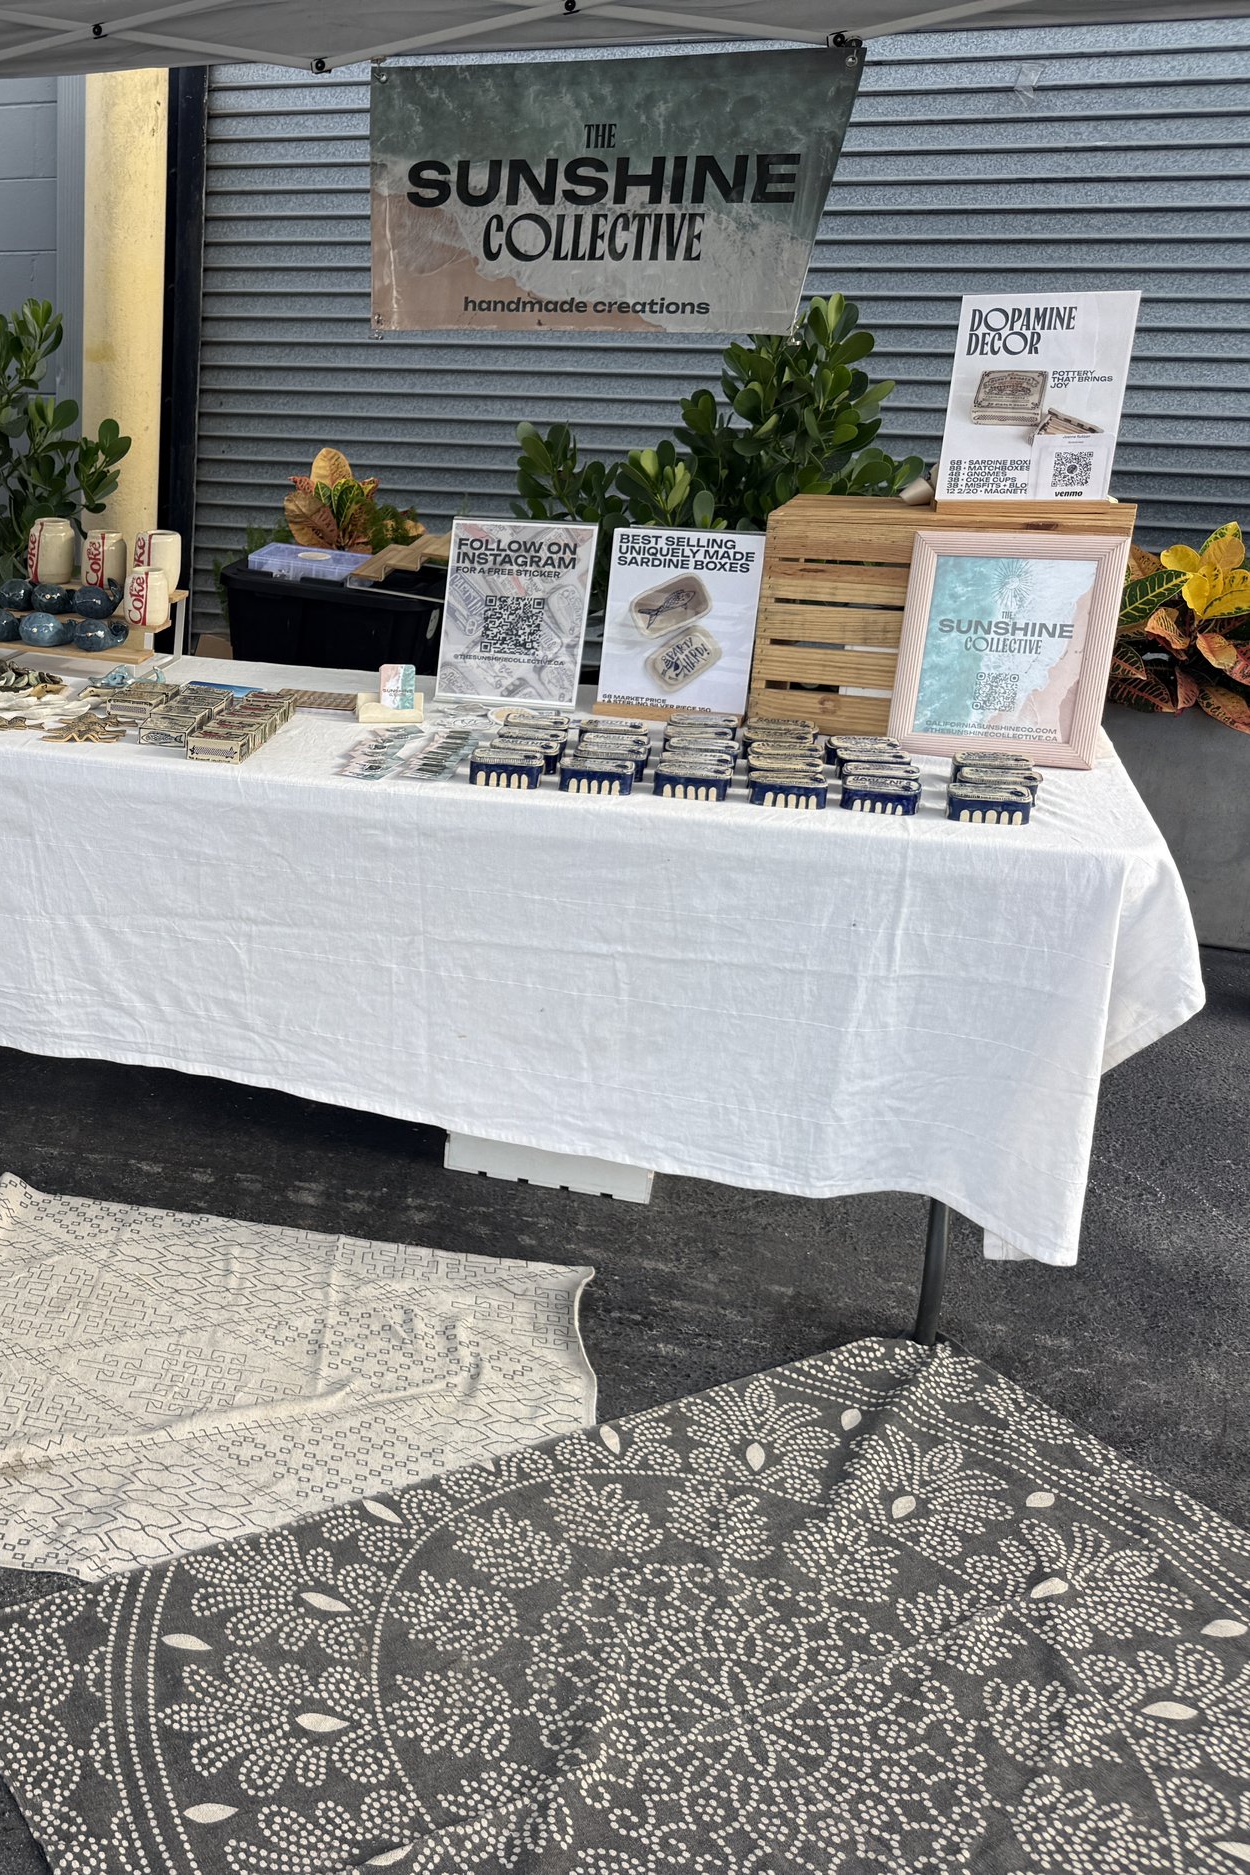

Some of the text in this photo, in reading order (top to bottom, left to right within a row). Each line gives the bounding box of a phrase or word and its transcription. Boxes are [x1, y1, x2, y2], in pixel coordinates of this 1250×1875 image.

[584, 123, 617, 149] THE
[406, 153, 801, 208] SUNSHINE
[483, 212, 705, 262] COLLECTIVE
[464, 296, 710, 315] handmade creations
[970, 306, 1077, 332] DOPAMINE
[966, 331, 1041, 355] DECOR
[458, 538, 577, 555] FOLLOW ON
[620, 534, 736, 550] BEST SELLING
[456, 552, 577, 569] INSTAGRAM
[619, 545, 755, 562] UNIQUELY MADE
[86, 541, 101, 586] Coke
[456, 566, 476, 574] FOR
[488, 568, 514, 576] FREE
[515, 570, 561, 578] STICKER
[618, 556, 750, 573] SARDINE BOXES
[128, 577, 144, 624] Coke
[1002, 611, 1013, 619] THE
[938, 618, 1074, 639] SUNSHINE
[669, 637, 694, 661] PARTY
[965, 637, 1042, 654] COLLECTIVE
[926, 720, 1057, 734] CALIFORNIASUNSHINECO.COM
